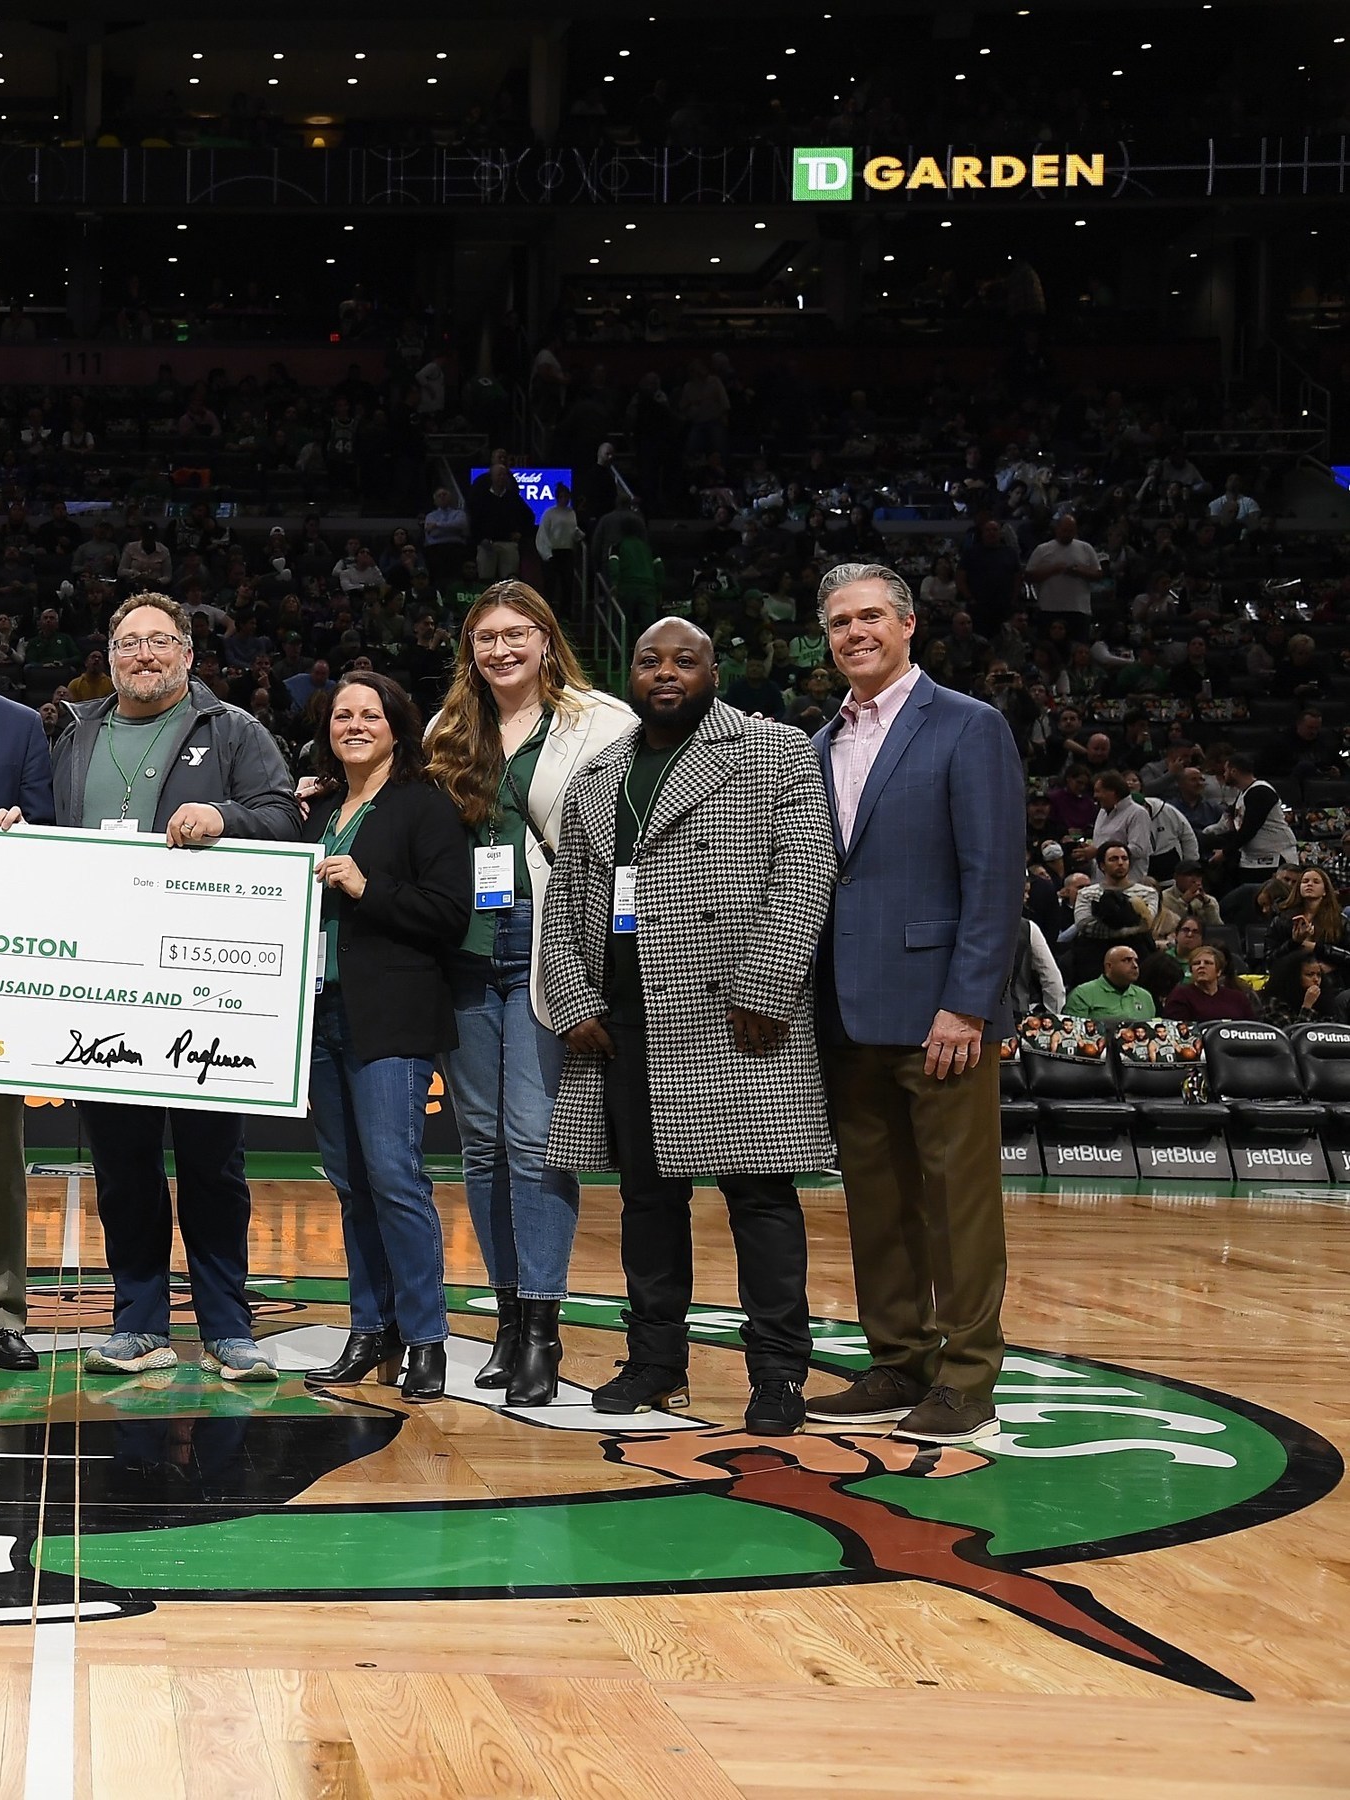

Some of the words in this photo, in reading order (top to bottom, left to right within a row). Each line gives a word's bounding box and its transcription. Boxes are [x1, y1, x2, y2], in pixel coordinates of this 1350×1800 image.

[797, 156, 848, 191] TD
[863, 154, 1105, 191] GARDEN
[61, 352, 101, 375] 111
[133, 877, 154, 888] Date
[165, 879, 231, 893] DECEMBER
[235, 884, 246, 896] 2,
[251, 885, 283, 897] 2022
[168, 944, 277, 968] $155,000.00
[59, 984, 139, 1004] DOLLARS
[142, 991, 183, 1007] AND
[1230, 1029, 1277, 1041] Putnam
[1057, 1144, 1122, 1164] jetBlue
[1150, 1146, 1217, 1166] jetBlue
[1246, 1147, 1313, 1168] jetBlue
